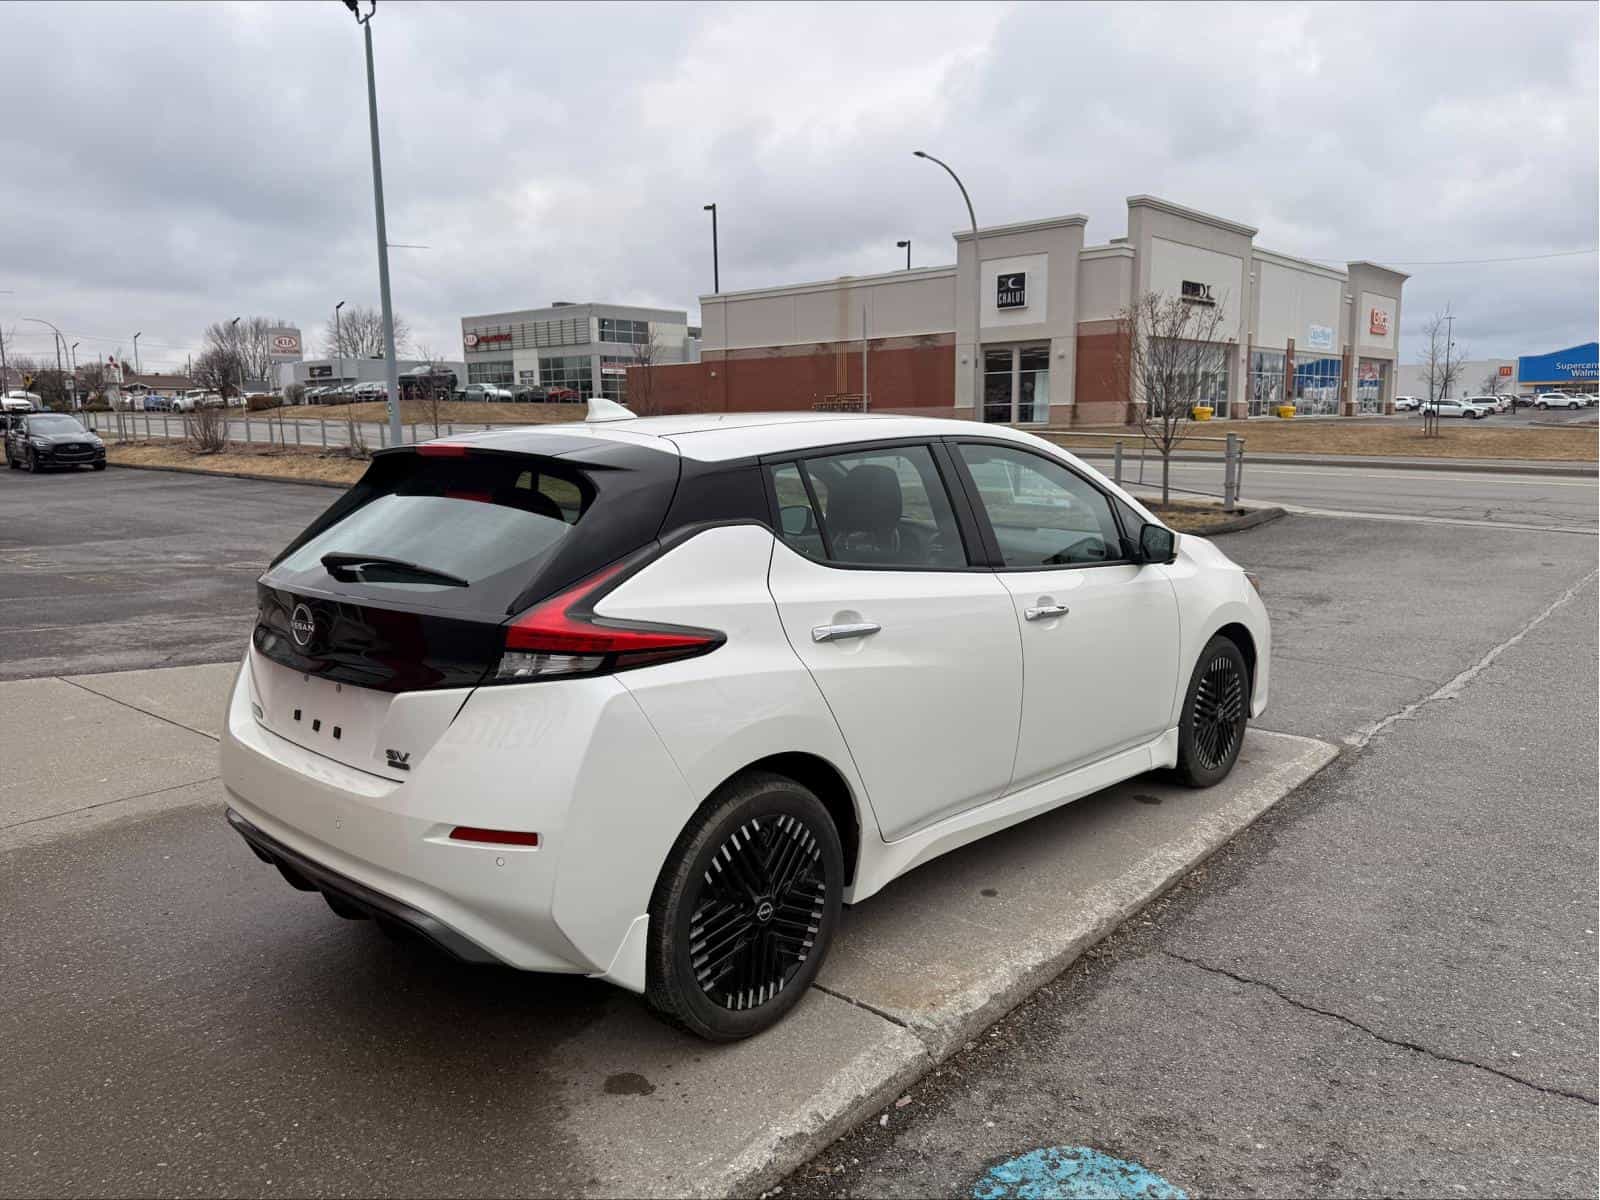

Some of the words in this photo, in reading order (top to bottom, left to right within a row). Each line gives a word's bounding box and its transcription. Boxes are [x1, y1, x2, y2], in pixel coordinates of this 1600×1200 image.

[998, 290, 1025, 305] CHALUT
[290, 620, 314, 632] NISSAN
[385, 749, 410, 762] SV
